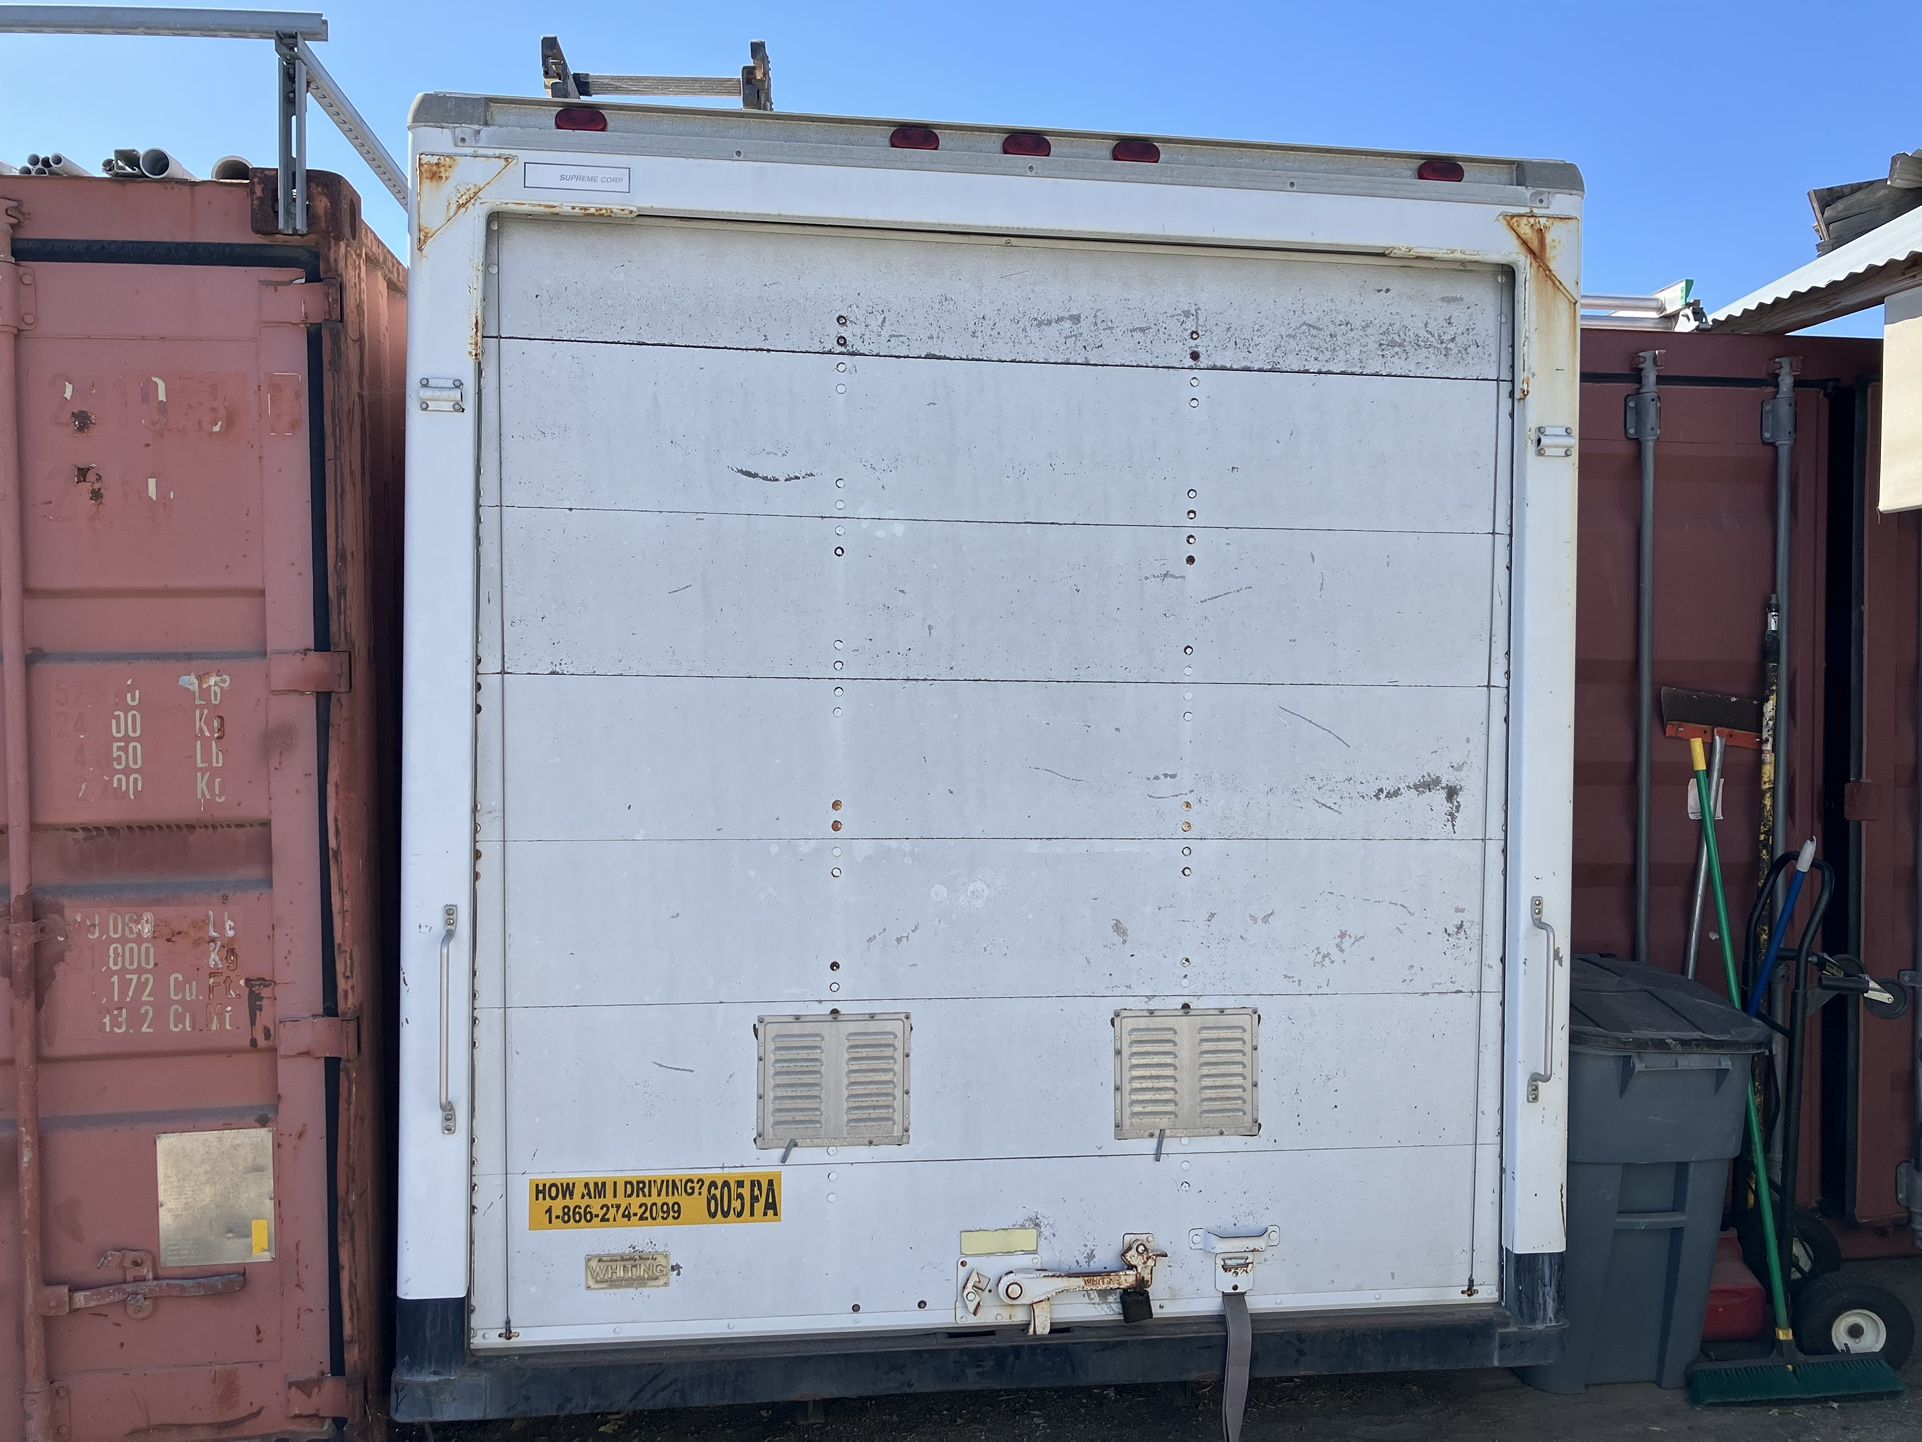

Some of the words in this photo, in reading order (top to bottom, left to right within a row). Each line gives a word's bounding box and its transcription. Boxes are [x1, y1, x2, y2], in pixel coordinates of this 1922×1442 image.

[559, 174, 599, 183] SUPREME
[196, 741, 223, 768] Lb
[535, 1182, 576, 1200] HOW
[580, 1181, 607, 1200] AM
[612, 1180, 618, 1199] I
[623, 1178, 705, 1198] DRIVING?
[544, 1201, 682, 1225] 1-866-274-2099
[587, 1263, 667, 1280] WHITING
